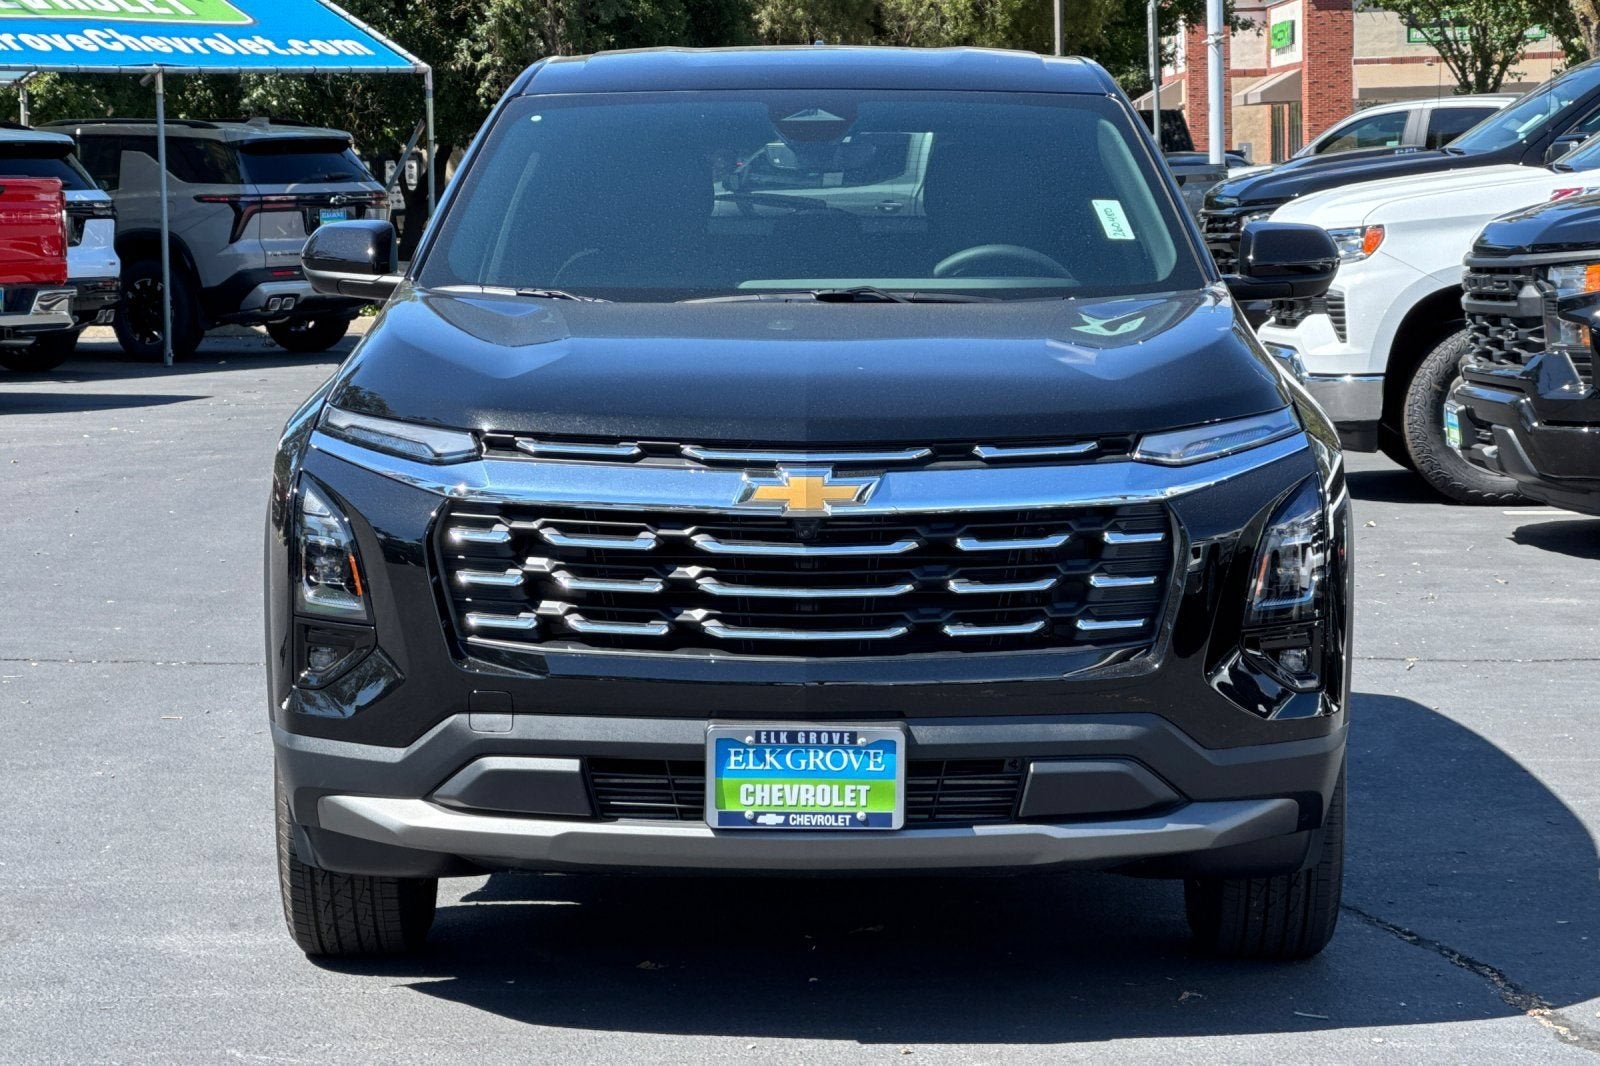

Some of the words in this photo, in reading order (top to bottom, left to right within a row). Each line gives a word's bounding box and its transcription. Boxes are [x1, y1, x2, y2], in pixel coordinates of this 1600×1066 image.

[0, 28, 376, 56] roveChevrolet.com
[760, 731, 788, 744] ELK
[797, 731, 851, 744] GROVE
[726, 748, 785, 770] ELK
[785, 748, 886, 772] GROVE
[739, 783, 871, 808] CHEVROLET
[788, 814, 852, 827] CHEVROLET
